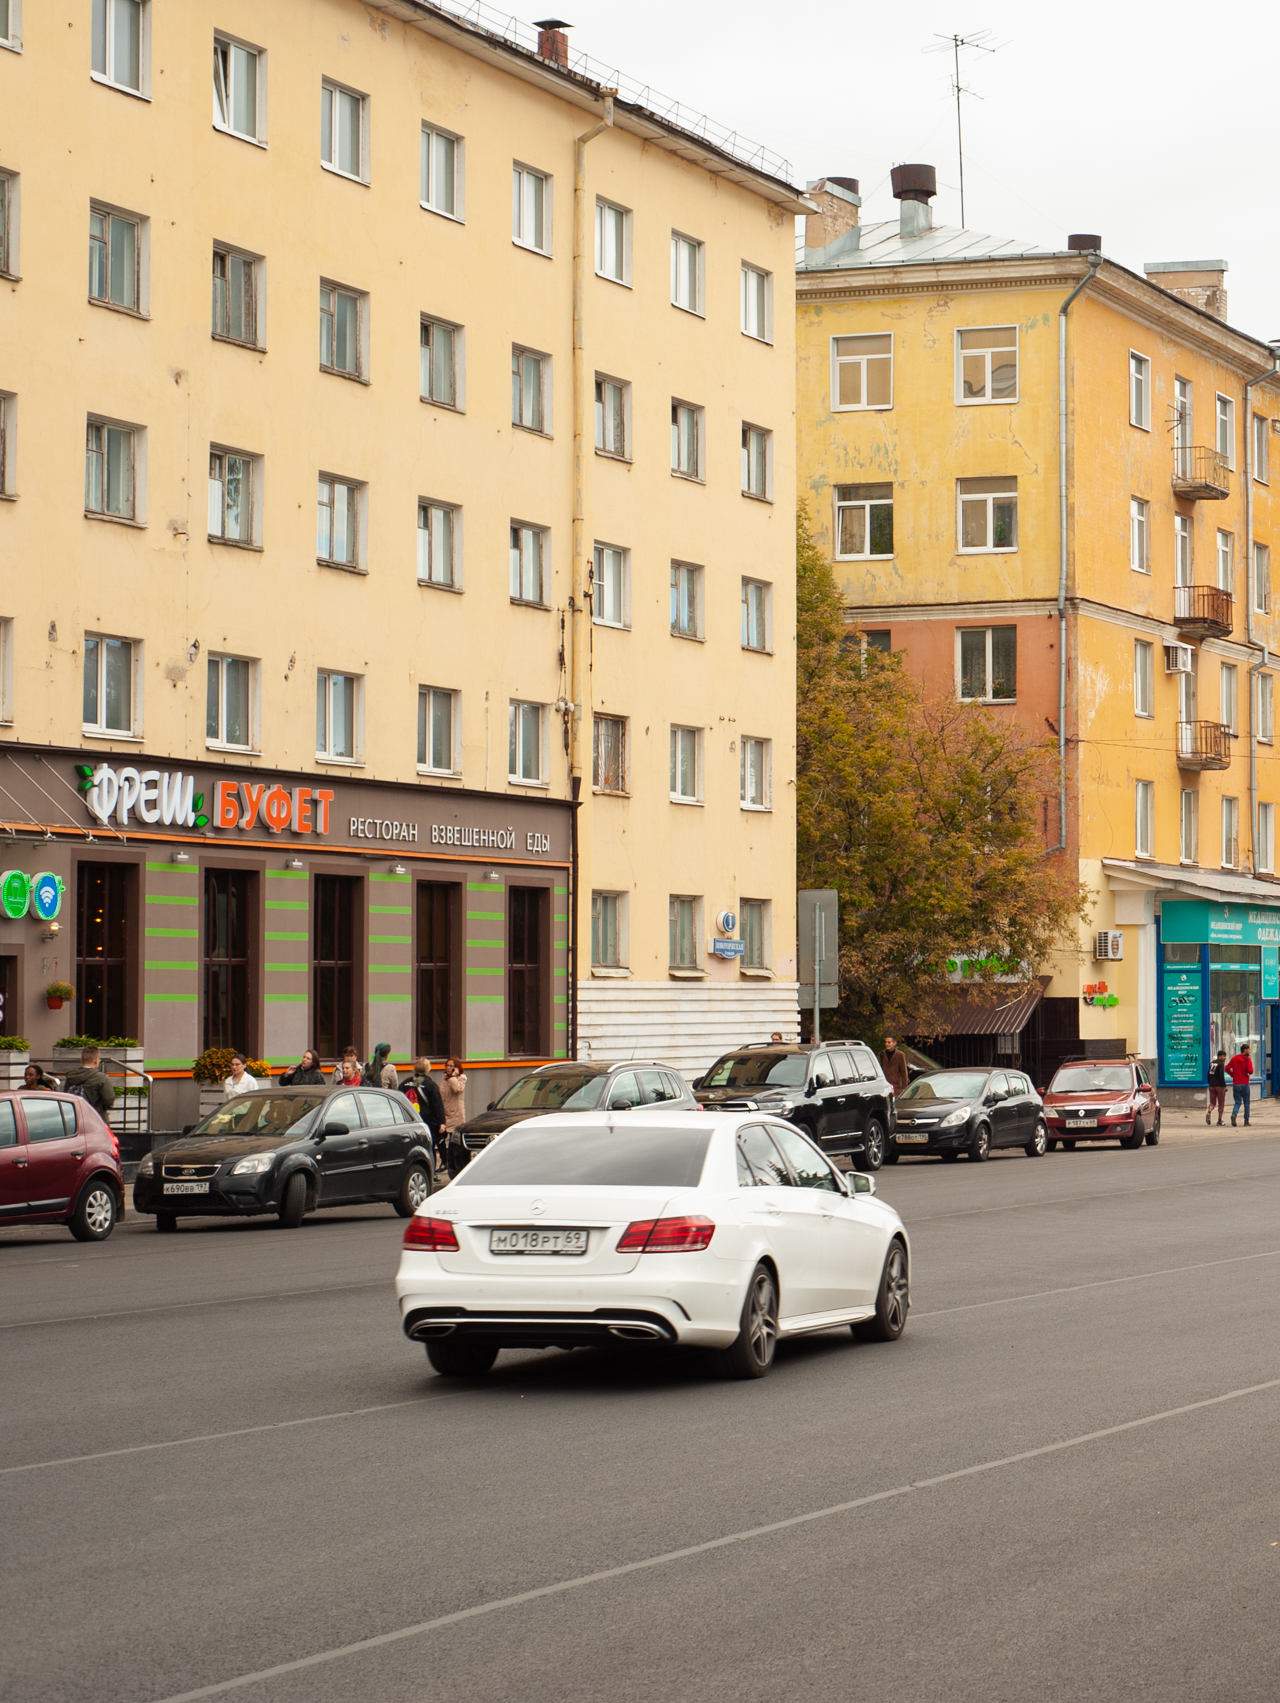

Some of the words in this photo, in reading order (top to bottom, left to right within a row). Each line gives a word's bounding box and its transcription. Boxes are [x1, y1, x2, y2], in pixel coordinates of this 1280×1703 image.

[88, 763, 195, 827] ФРЕШ
[213, 781, 334, 835] БУФЕТ
[349, 817, 418, 842] РЕСТОРАН
[431, 825, 515, 849] ВЗВЕШЕННОЙ
[526, 832, 550, 853] ЕДЫ
